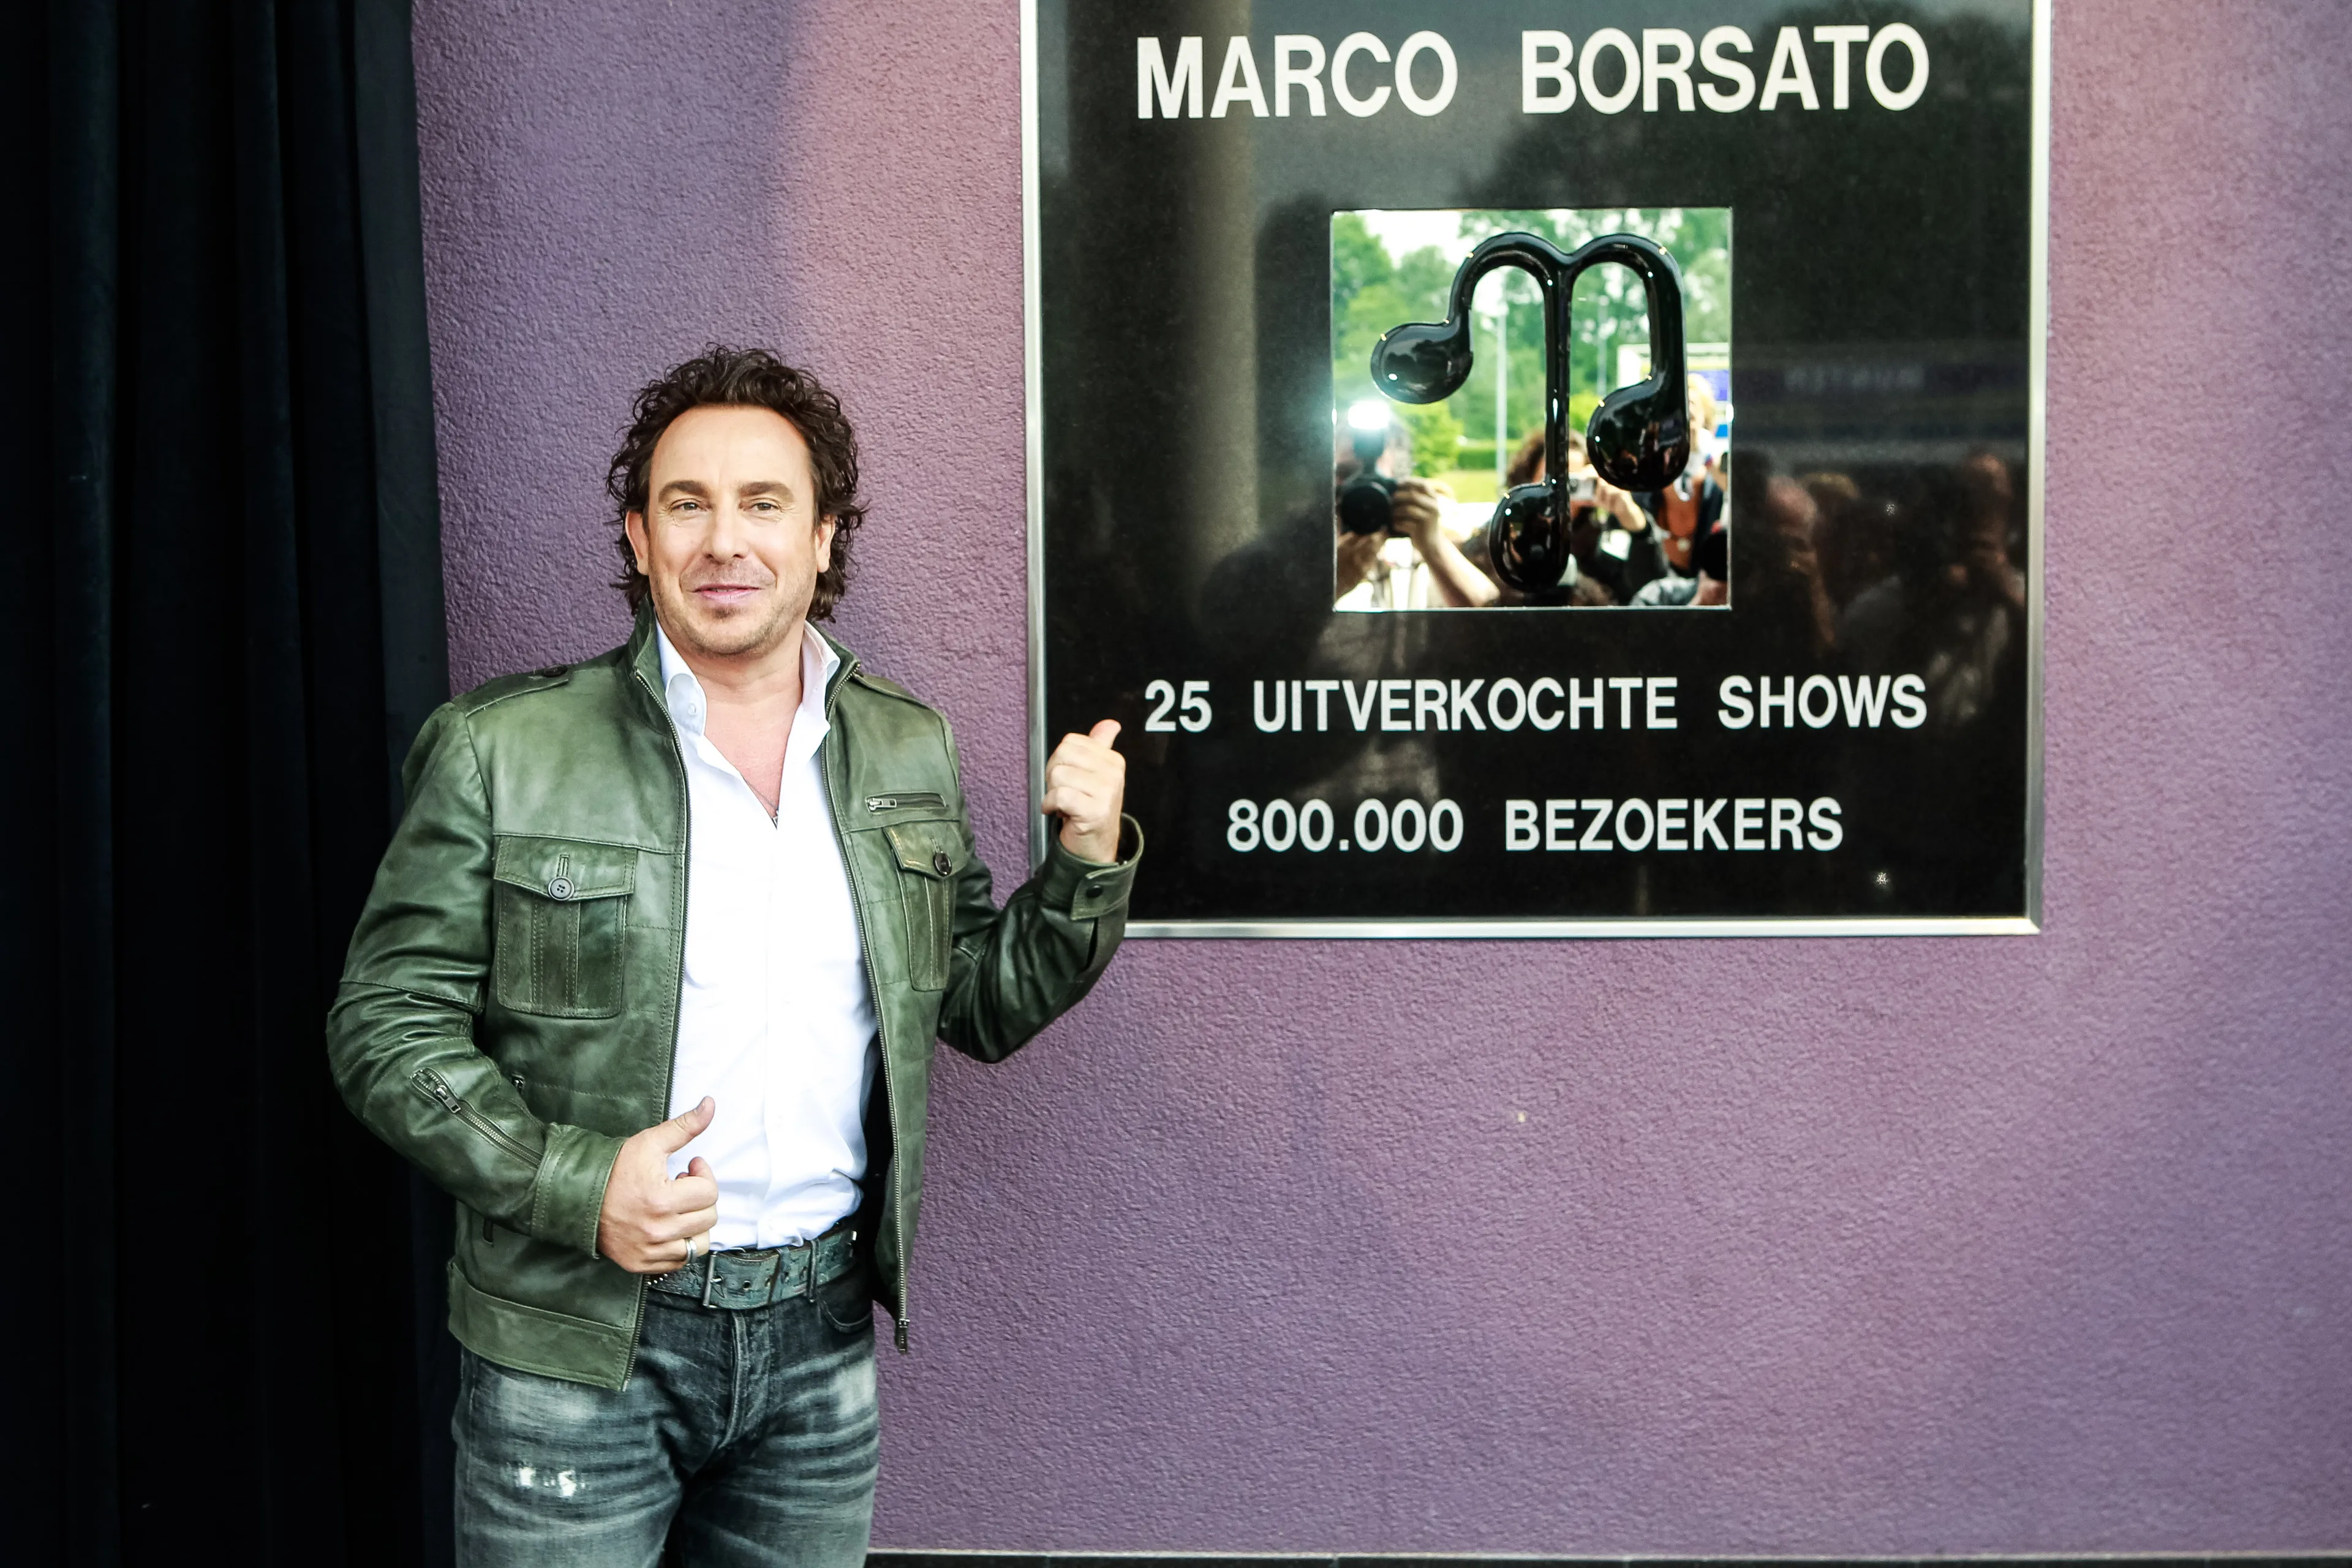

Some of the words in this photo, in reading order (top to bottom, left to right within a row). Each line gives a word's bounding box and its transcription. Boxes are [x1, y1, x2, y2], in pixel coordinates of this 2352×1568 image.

[1138, 31, 1458, 118] MARCO
[1522, 23, 1929, 114] BORSATO
[1145, 680, 1211, 732] 25
[1254, 677, 1677, 732] UITVERKOCHTE
[1719, 674, 1926, 728] SHOWS
[1227, 799, 1463, 851] 800.000
[1506, 798, 1842, 851] BEZOEKERS
